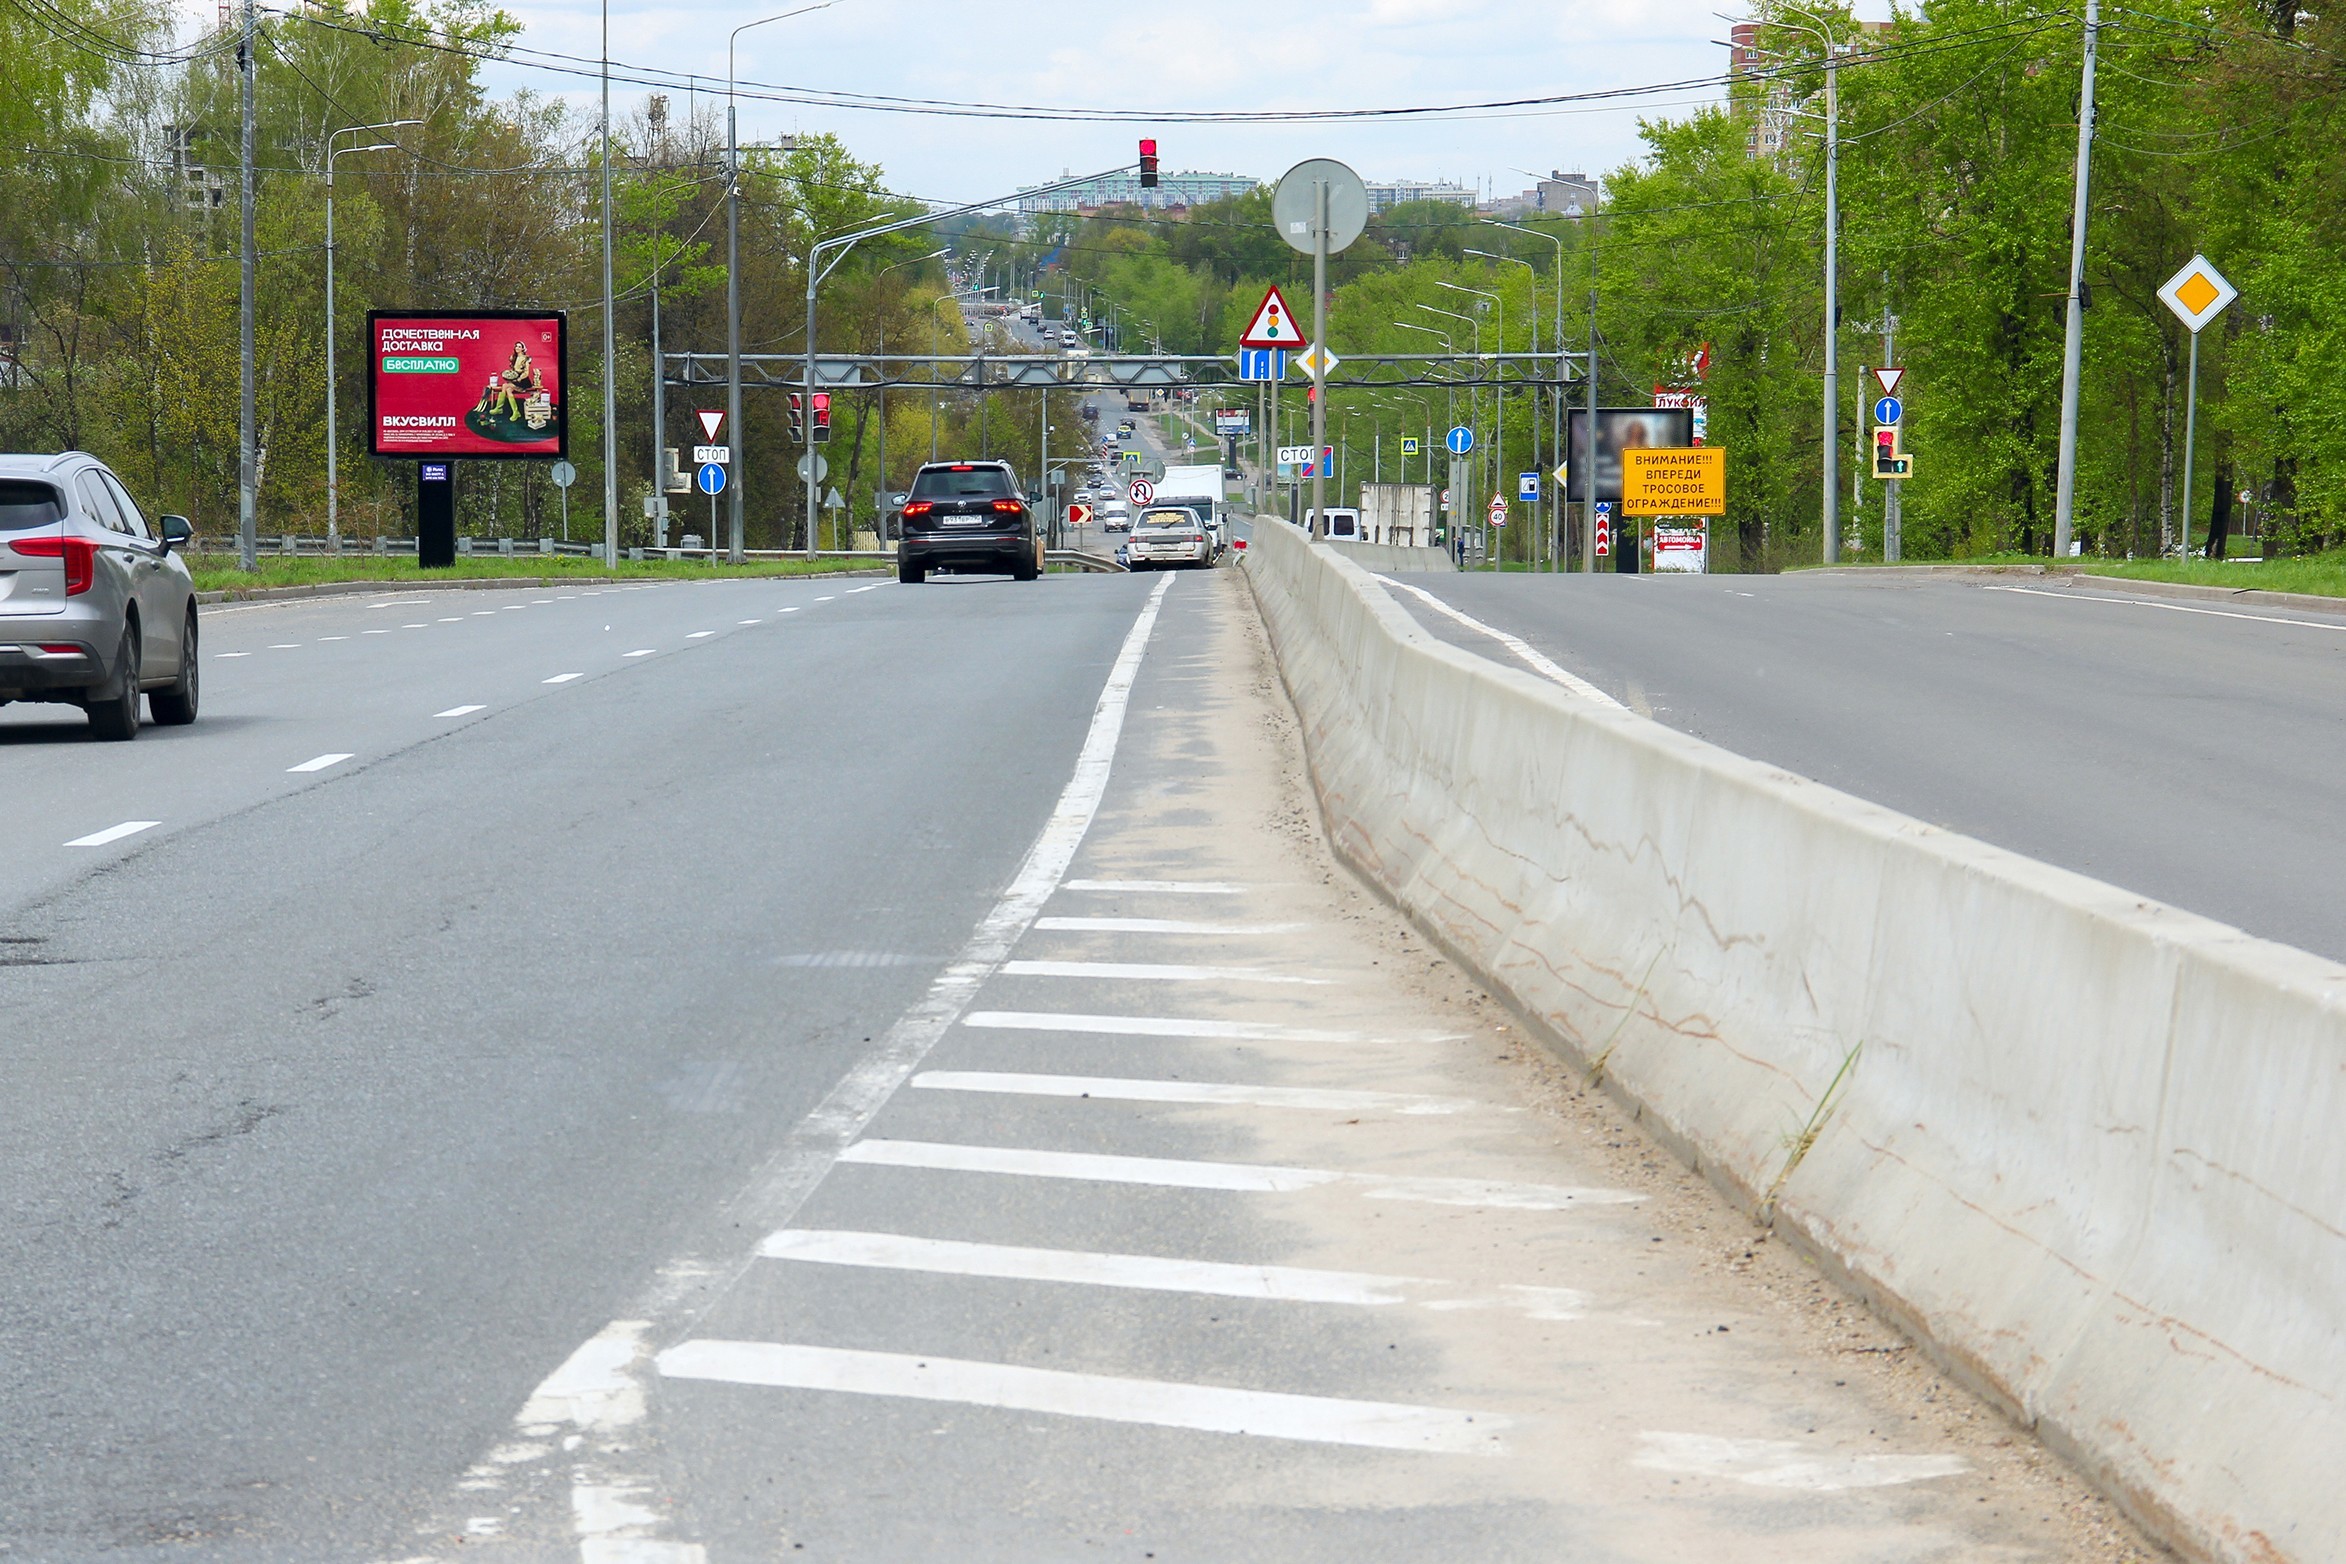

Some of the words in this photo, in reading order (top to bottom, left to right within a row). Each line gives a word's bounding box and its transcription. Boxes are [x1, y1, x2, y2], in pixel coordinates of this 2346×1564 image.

[381, 328, 480, 341] ДАЧЕСТВЕННАЯ
[381, 341, 443, 352] ДОСТАВКА
[386, 359, 456, 370] БЕСПЛАТНО
[382, 415, 456, 427] ВКУСВИЛЛ
[697, 448, 726, 460] СТОП
[1635, 455, 1713, 465] ВНИМАНИЕ!!!
[1646, 469, 1701, 480] ВПЕРЕДИ
[1642, 483, 1705, 494] ТРОСОВОЕ
[1627, 498, 1721, 509] ОГРАЖДЕНИЕ!!!
